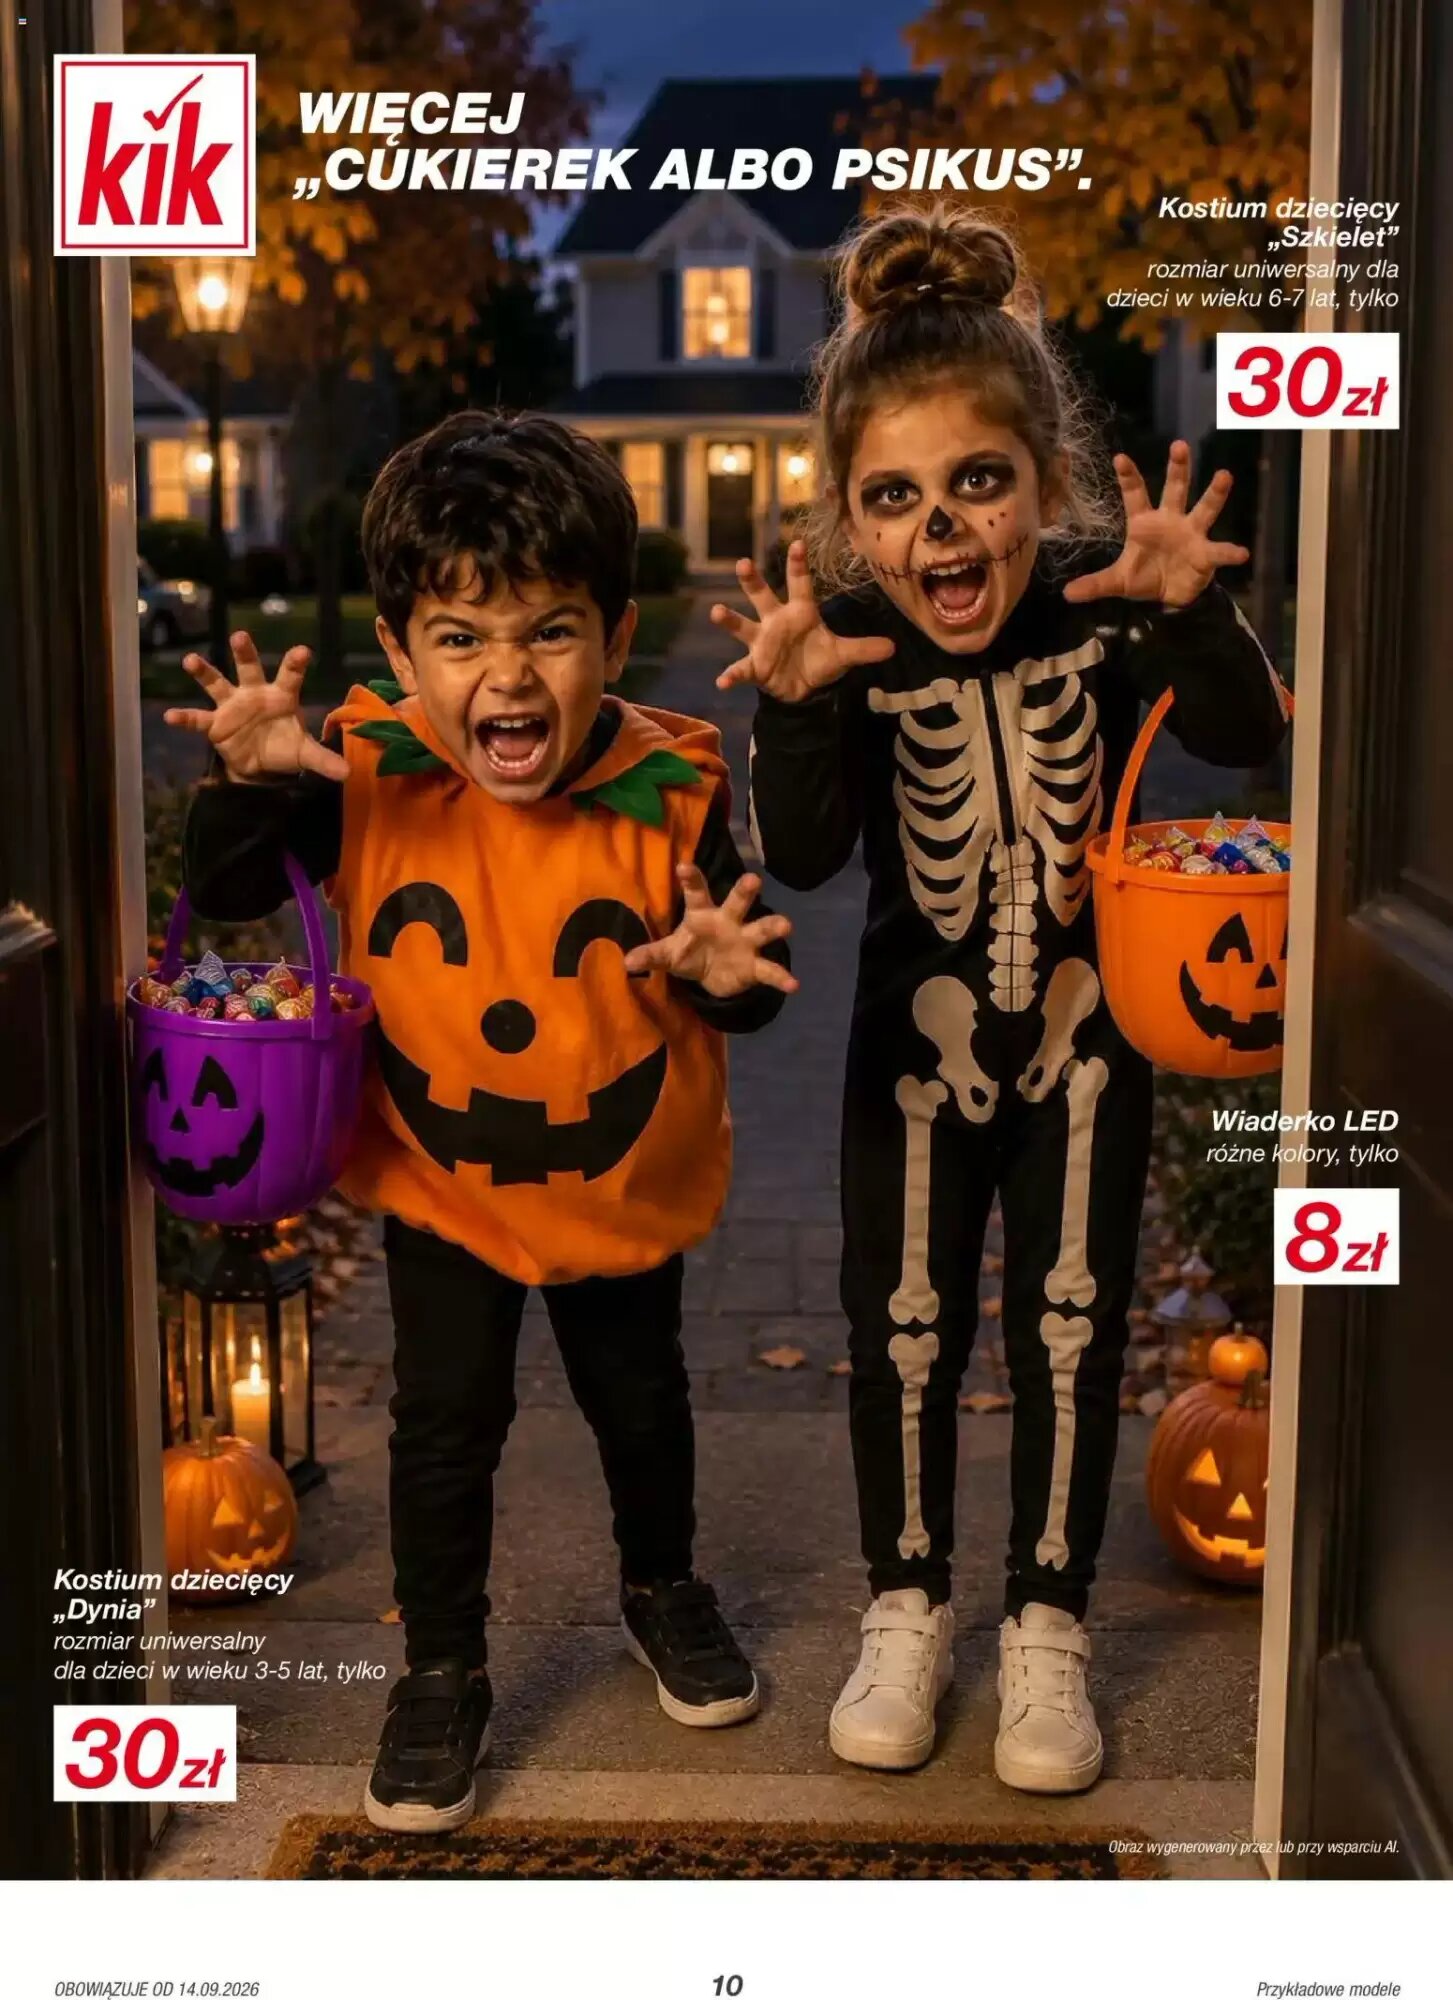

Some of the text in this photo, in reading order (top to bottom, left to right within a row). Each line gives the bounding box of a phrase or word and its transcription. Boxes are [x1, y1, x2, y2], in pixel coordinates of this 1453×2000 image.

[299, 91, 525, 147] WIĘCEJ
[292, 148, 1093, 200] „CUKIEREK ALBO PSIKUS”.
[1158, 197, 1400, 223] Kostium dziecięcy
[1267, 225, 1400, 251] „Szkielet”
[1147, 259, 1400, 283] rozmiar uniwersalny dla
[1106, 288, 1400, 312] dzieci w wieku 6-7 lat, tylko
[1212, 1109, 1400, 1132] Wiaderko LED
[1205, 1143, 1400, 1168] różne kolory, tylko
[53, 1568, 295, 1596] Kostium dziecięcy
[52, 1597, 157, 1625] „Dynia”
[53, 1631, 267, 1655] rozmiar uniwersalny
[53, 1661, 387, 1684] dla dzieci w wieku 3-5 lat, tylko
[1108, 1840, 1400, 1857] Obraz wygenerowany przez lub przy wsparciu AI.
[54, 1981, 260, 2000] OBOWIĄZUJE OD 14.09.2026
[712, 1974, 744, 1997] 10
[1256, 1981, 1401, 2000] Przykładowe modele
